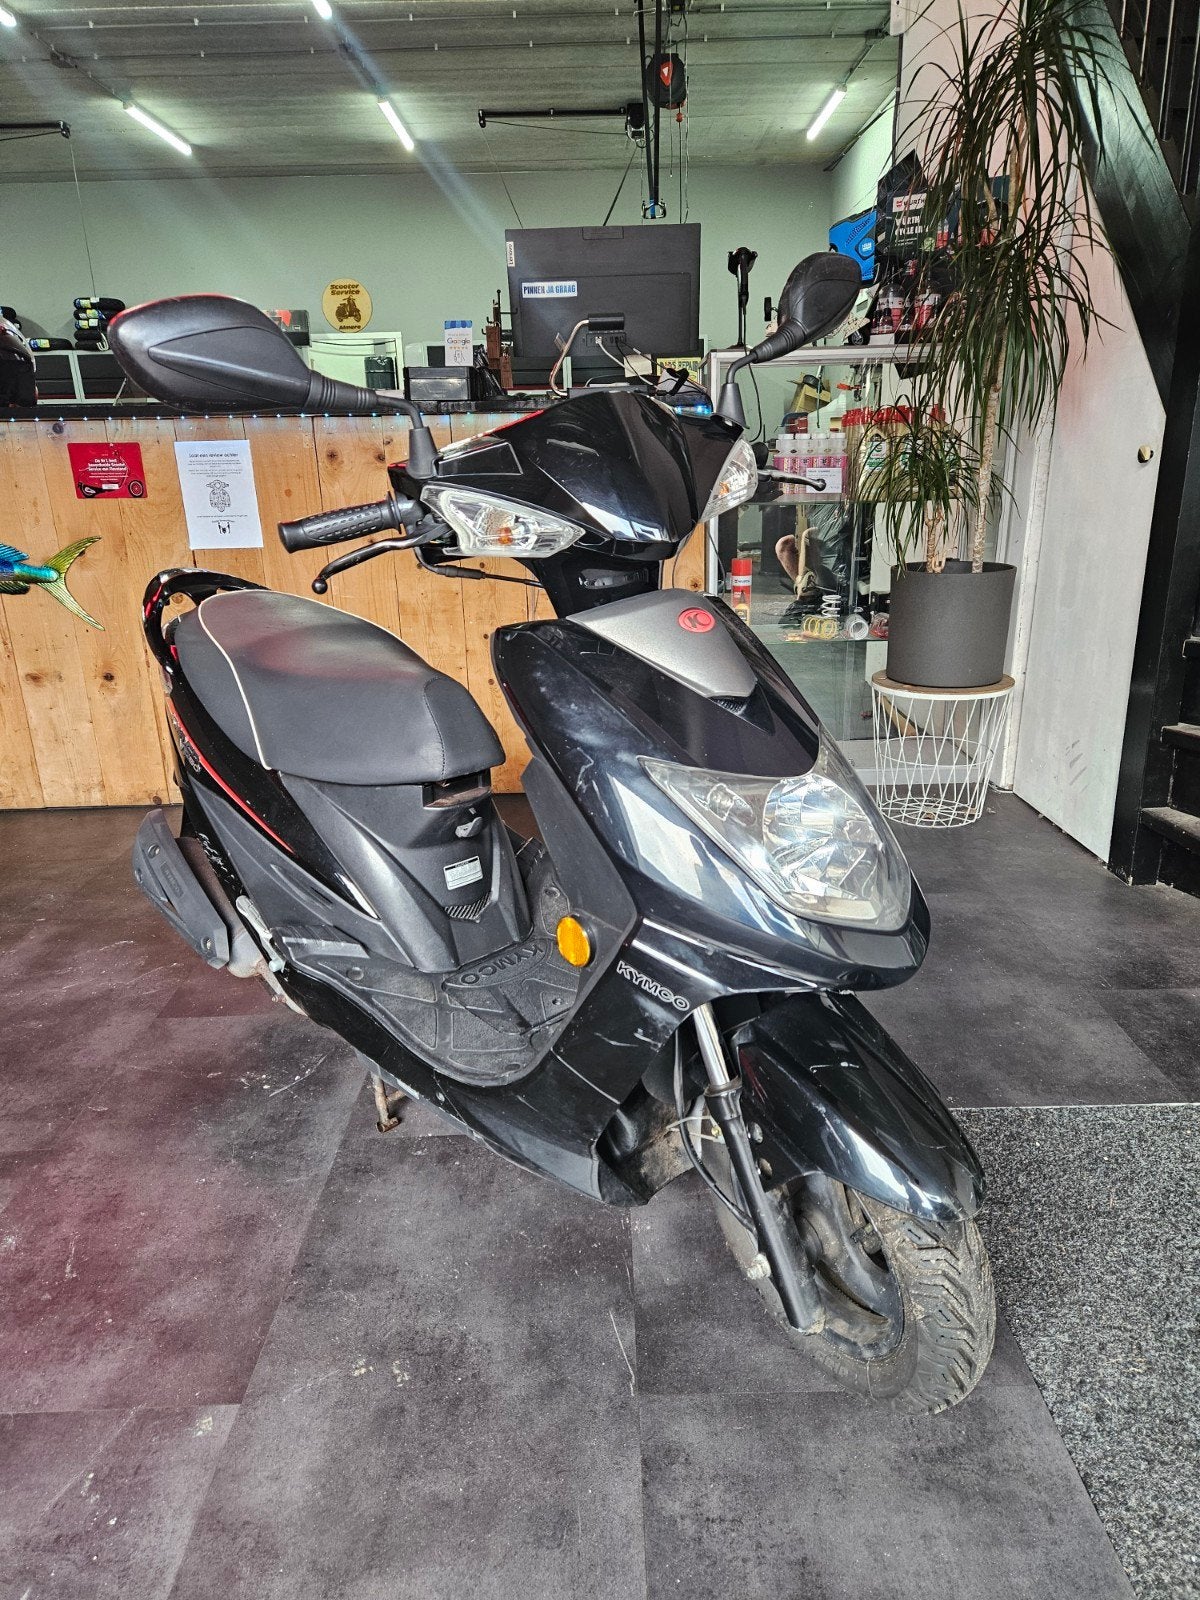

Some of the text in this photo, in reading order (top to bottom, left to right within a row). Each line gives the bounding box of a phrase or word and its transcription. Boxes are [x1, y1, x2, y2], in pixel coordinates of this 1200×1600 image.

[523, 284, 576, 295] PINNEN JA GRAAG
[447, 337, 470, 346] Google
[461, 943, 544, 984] KYMCO
[616, 960, 690, 1011] KYMCO
